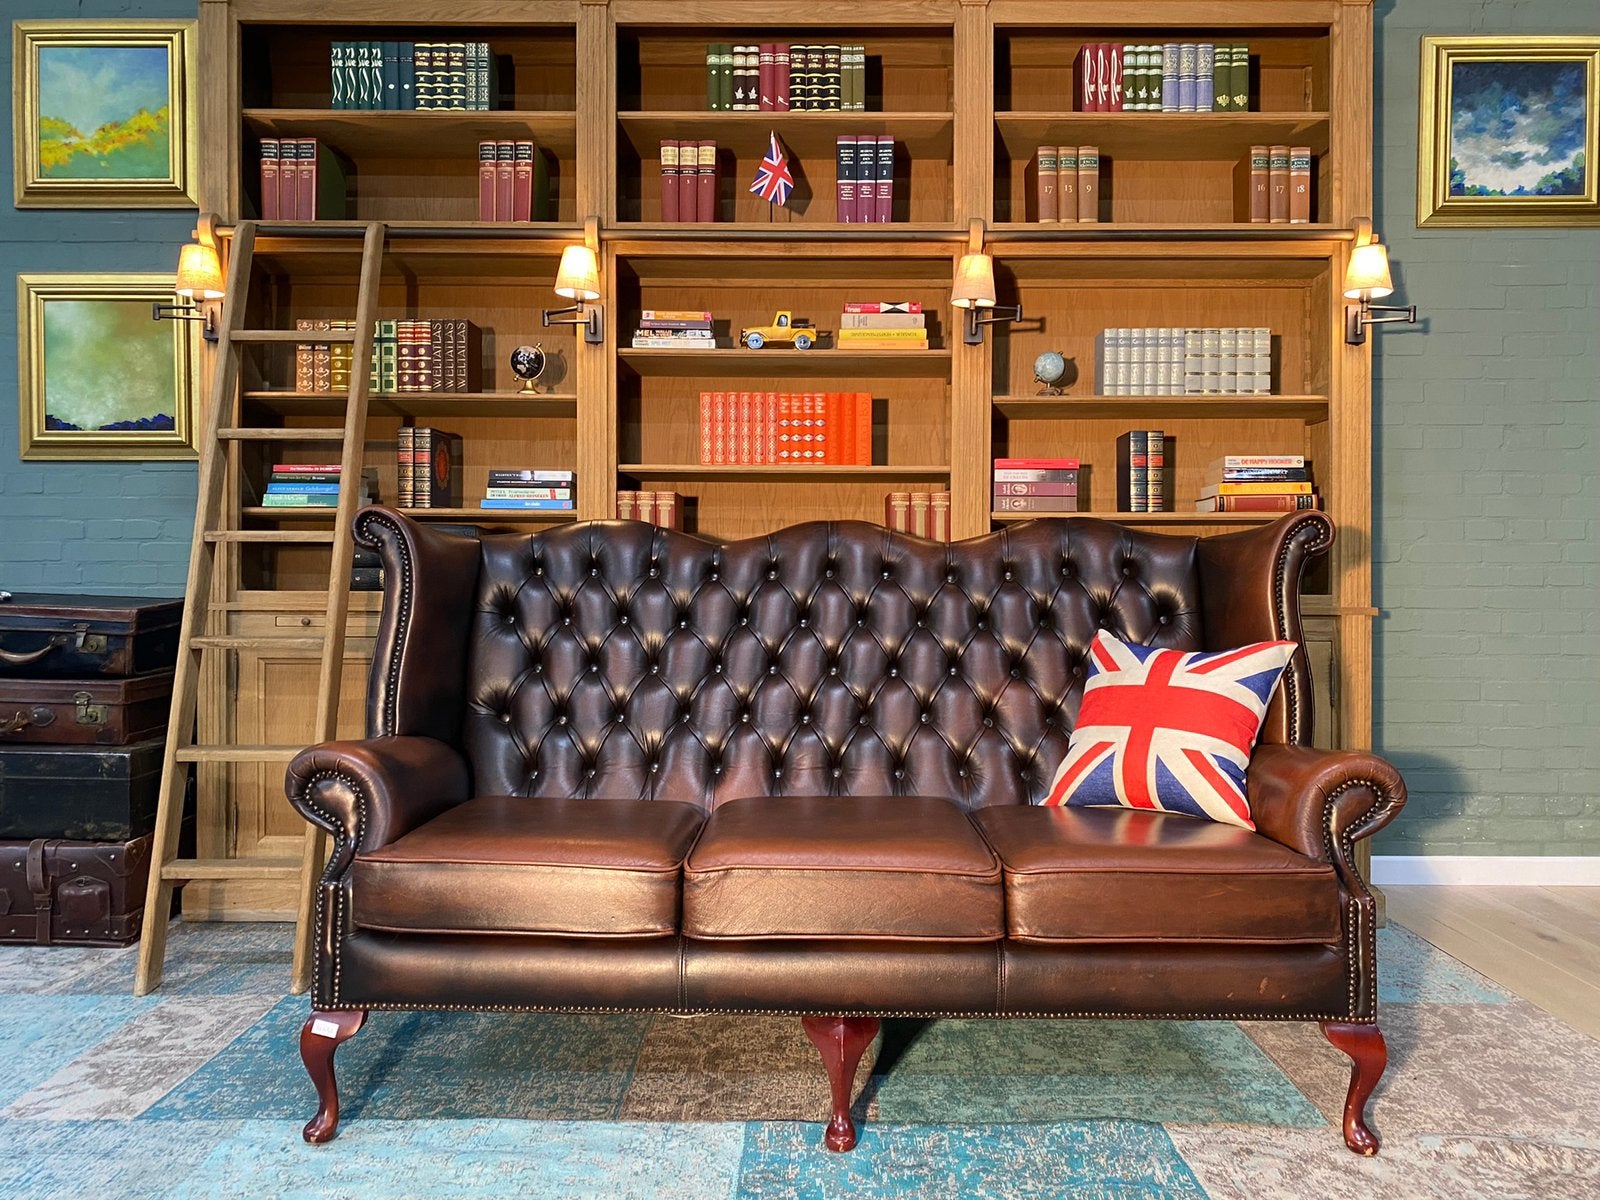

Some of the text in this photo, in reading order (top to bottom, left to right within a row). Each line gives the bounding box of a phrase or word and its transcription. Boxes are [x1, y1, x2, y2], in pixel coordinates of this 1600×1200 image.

[1044, 185, 1053, 195] 17
[1064, 184, 1073, 193] 13
[1086, 184, 1092, 193] 9
[1257, 184, 1266, 192] 16
[1276, 185, 1285, 194] 17
[1296, 184, 1305, 193] 18
[636, 329, 655, 337] MEL
[432, 322, 442, 390] WELTATLAS
[444, 322, 454, 390] WELTATLAS
[456, 322, 466, 389] WELTATLAS
